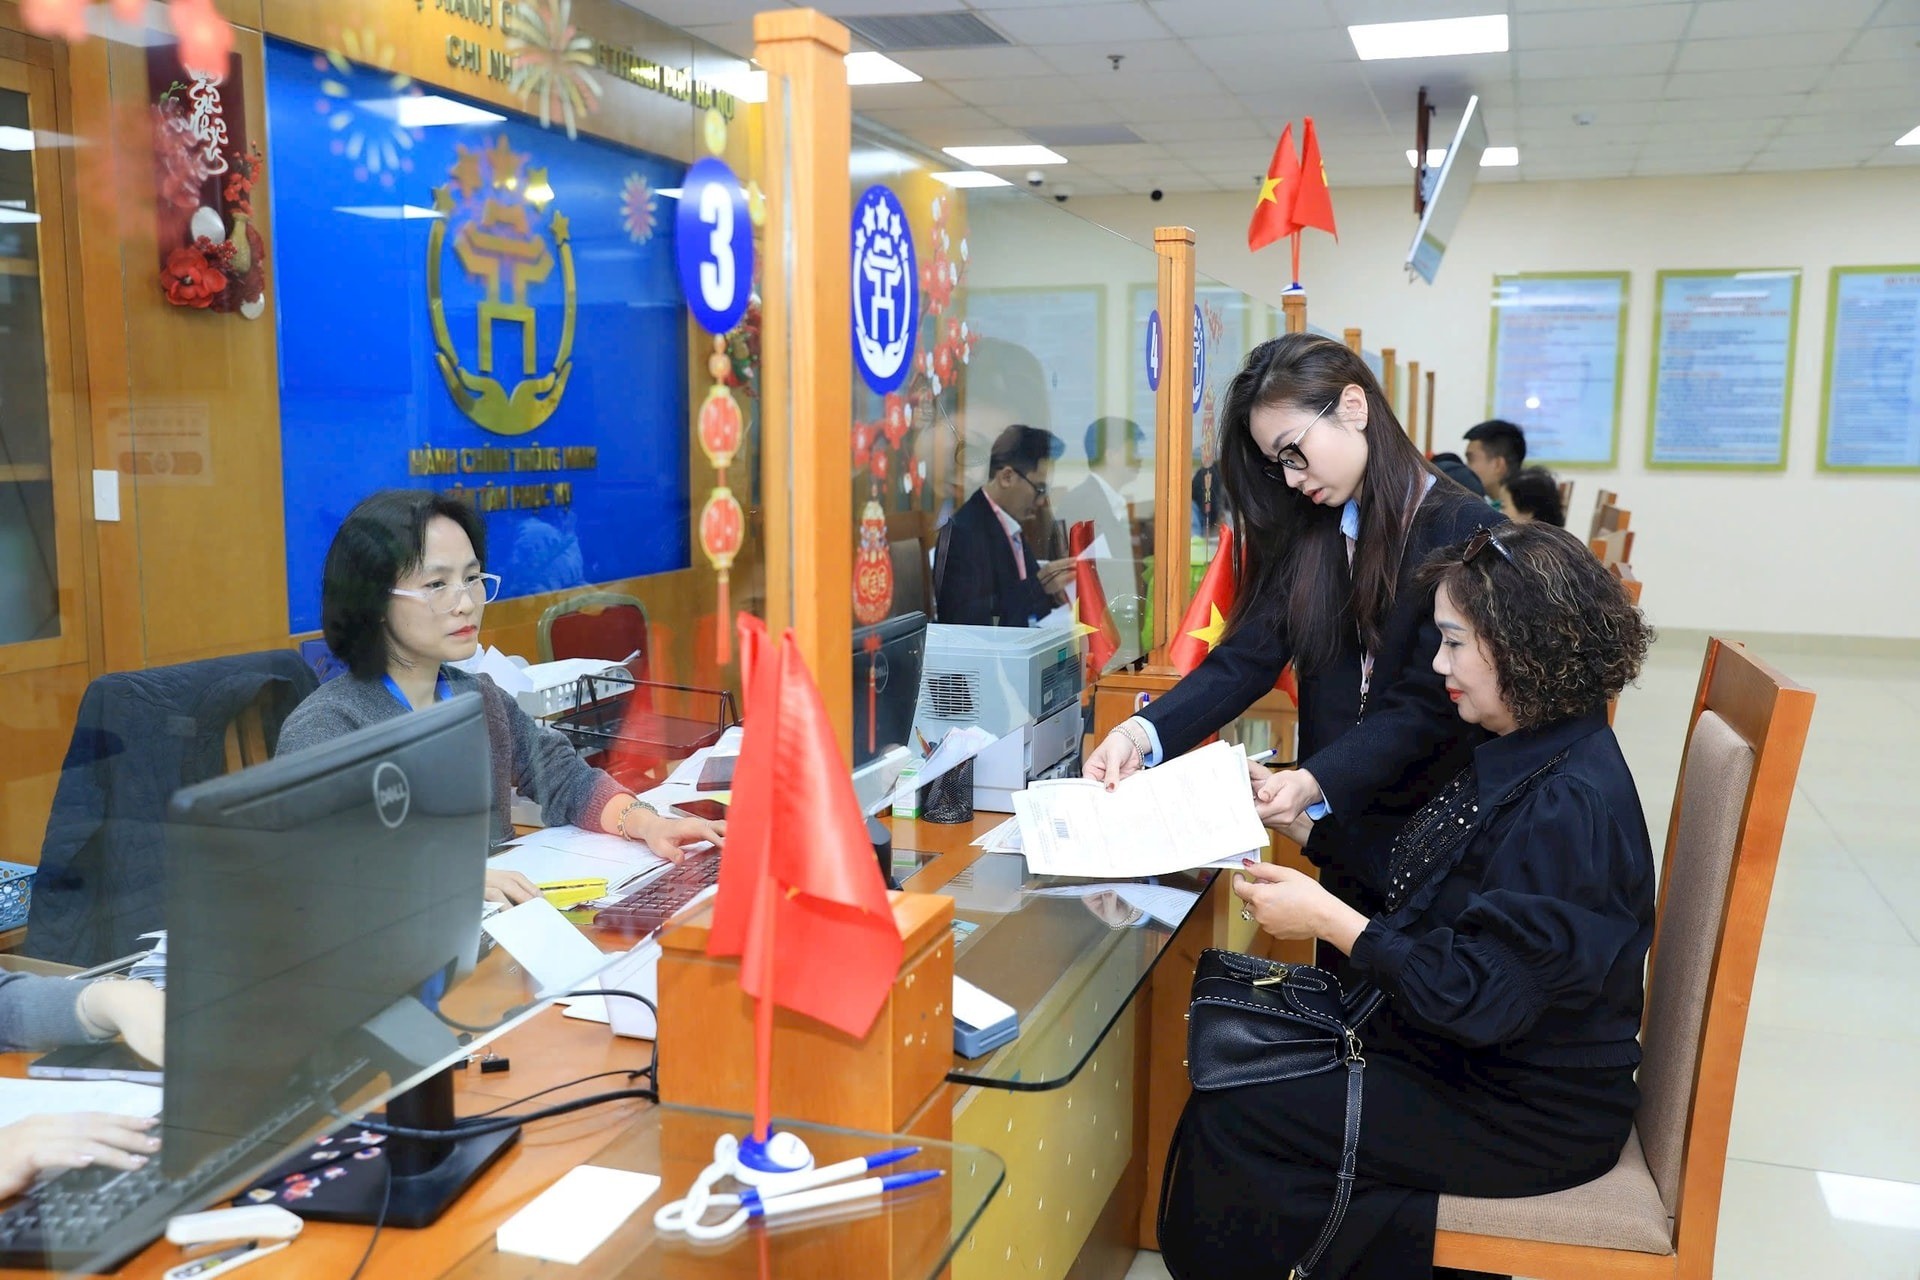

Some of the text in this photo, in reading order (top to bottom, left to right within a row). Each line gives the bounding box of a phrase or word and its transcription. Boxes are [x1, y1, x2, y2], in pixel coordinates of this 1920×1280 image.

[446, 35, 481, 72] CHI
[699, 181, 735, 312] 3
[1150, 321, 1159, 379] 4
[409, 442, 458, 476] HÀNH
[460, 442, 510, 474] CHÍNH
[511, 441, 561, 472] THÔNG
[380, 783, 406, 806] DELL
